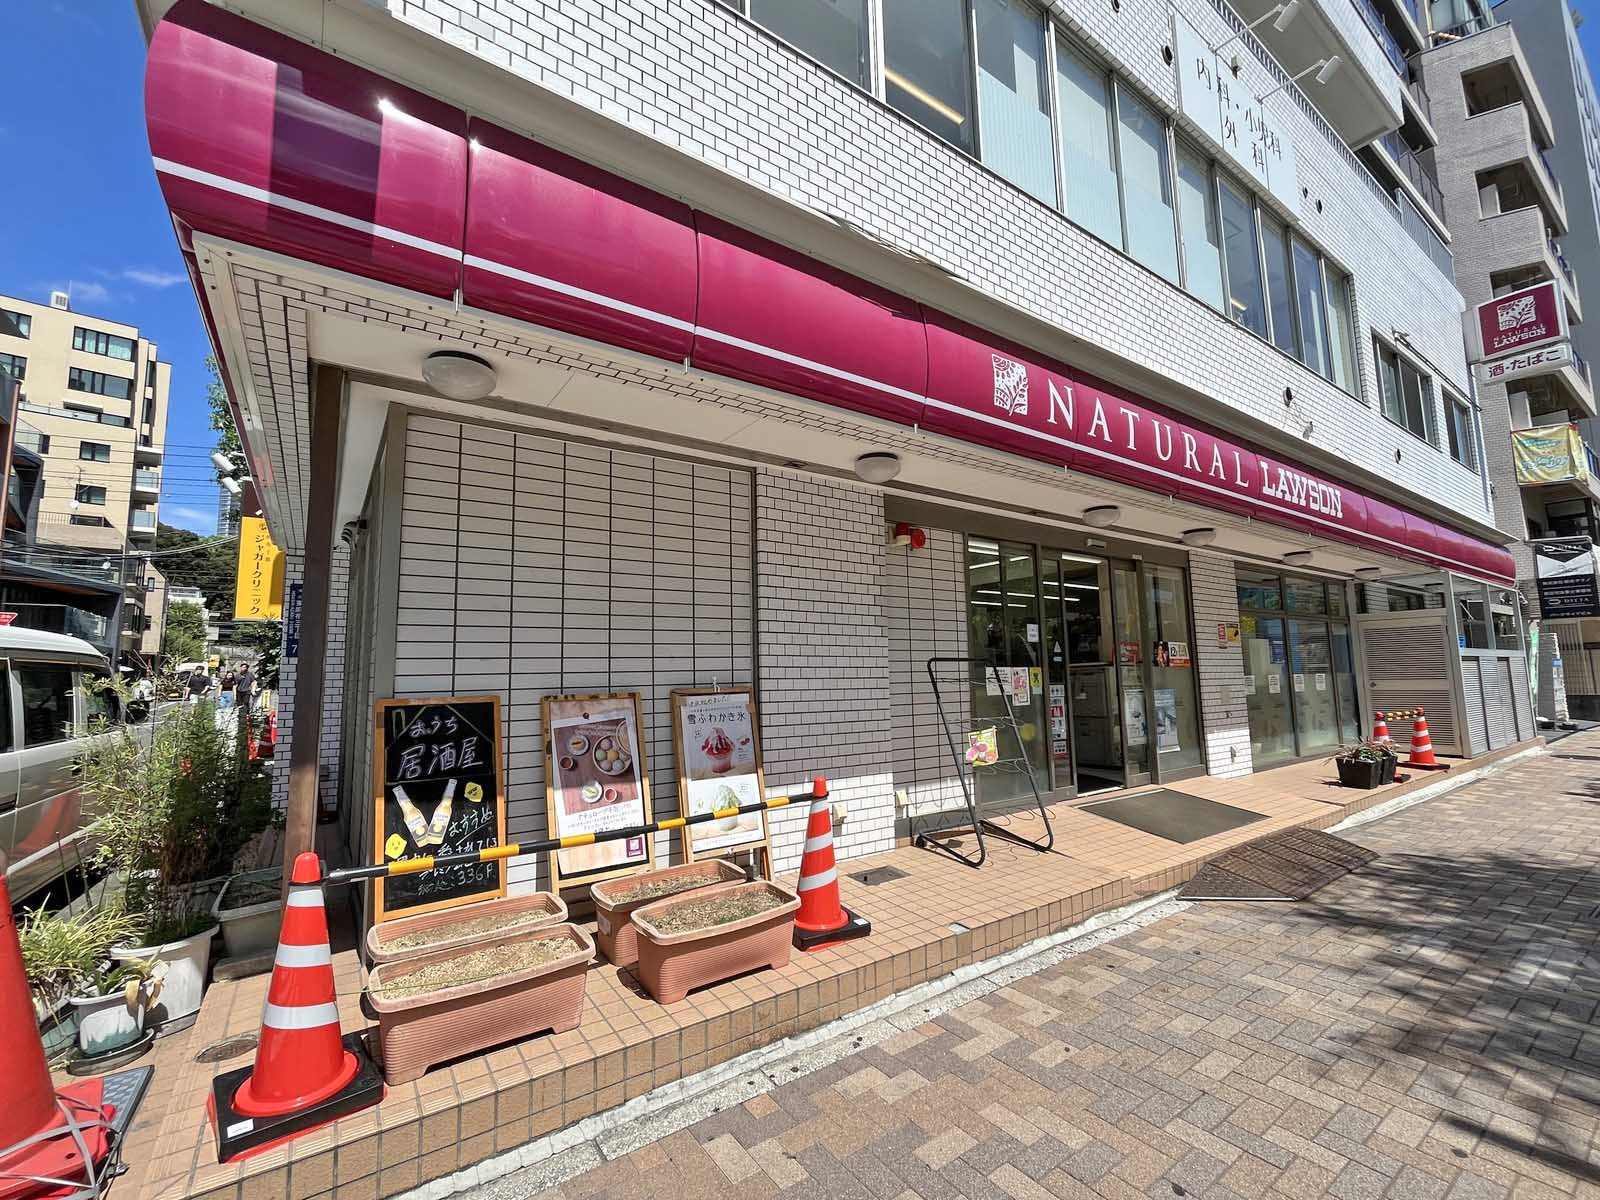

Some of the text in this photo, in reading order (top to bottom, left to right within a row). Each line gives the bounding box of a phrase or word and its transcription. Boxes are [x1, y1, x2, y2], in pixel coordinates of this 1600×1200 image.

[1493, 323, 1544, 341] NATURAL
[1493, 327, 1547, 349] LAWSON
[1489, 350, 1561, 378] 酒・たばこ
[1047, 378, 1343, 519] NATURAL LAWSON
[250, 534, 265, 615] ジャガークリニック
[291, 644, 298, 654] 7
[409, 715, 458, 738] おうち
[397, 736, 484, 779] 居酒屋
[448, 807, 494, 837] おすすめ
